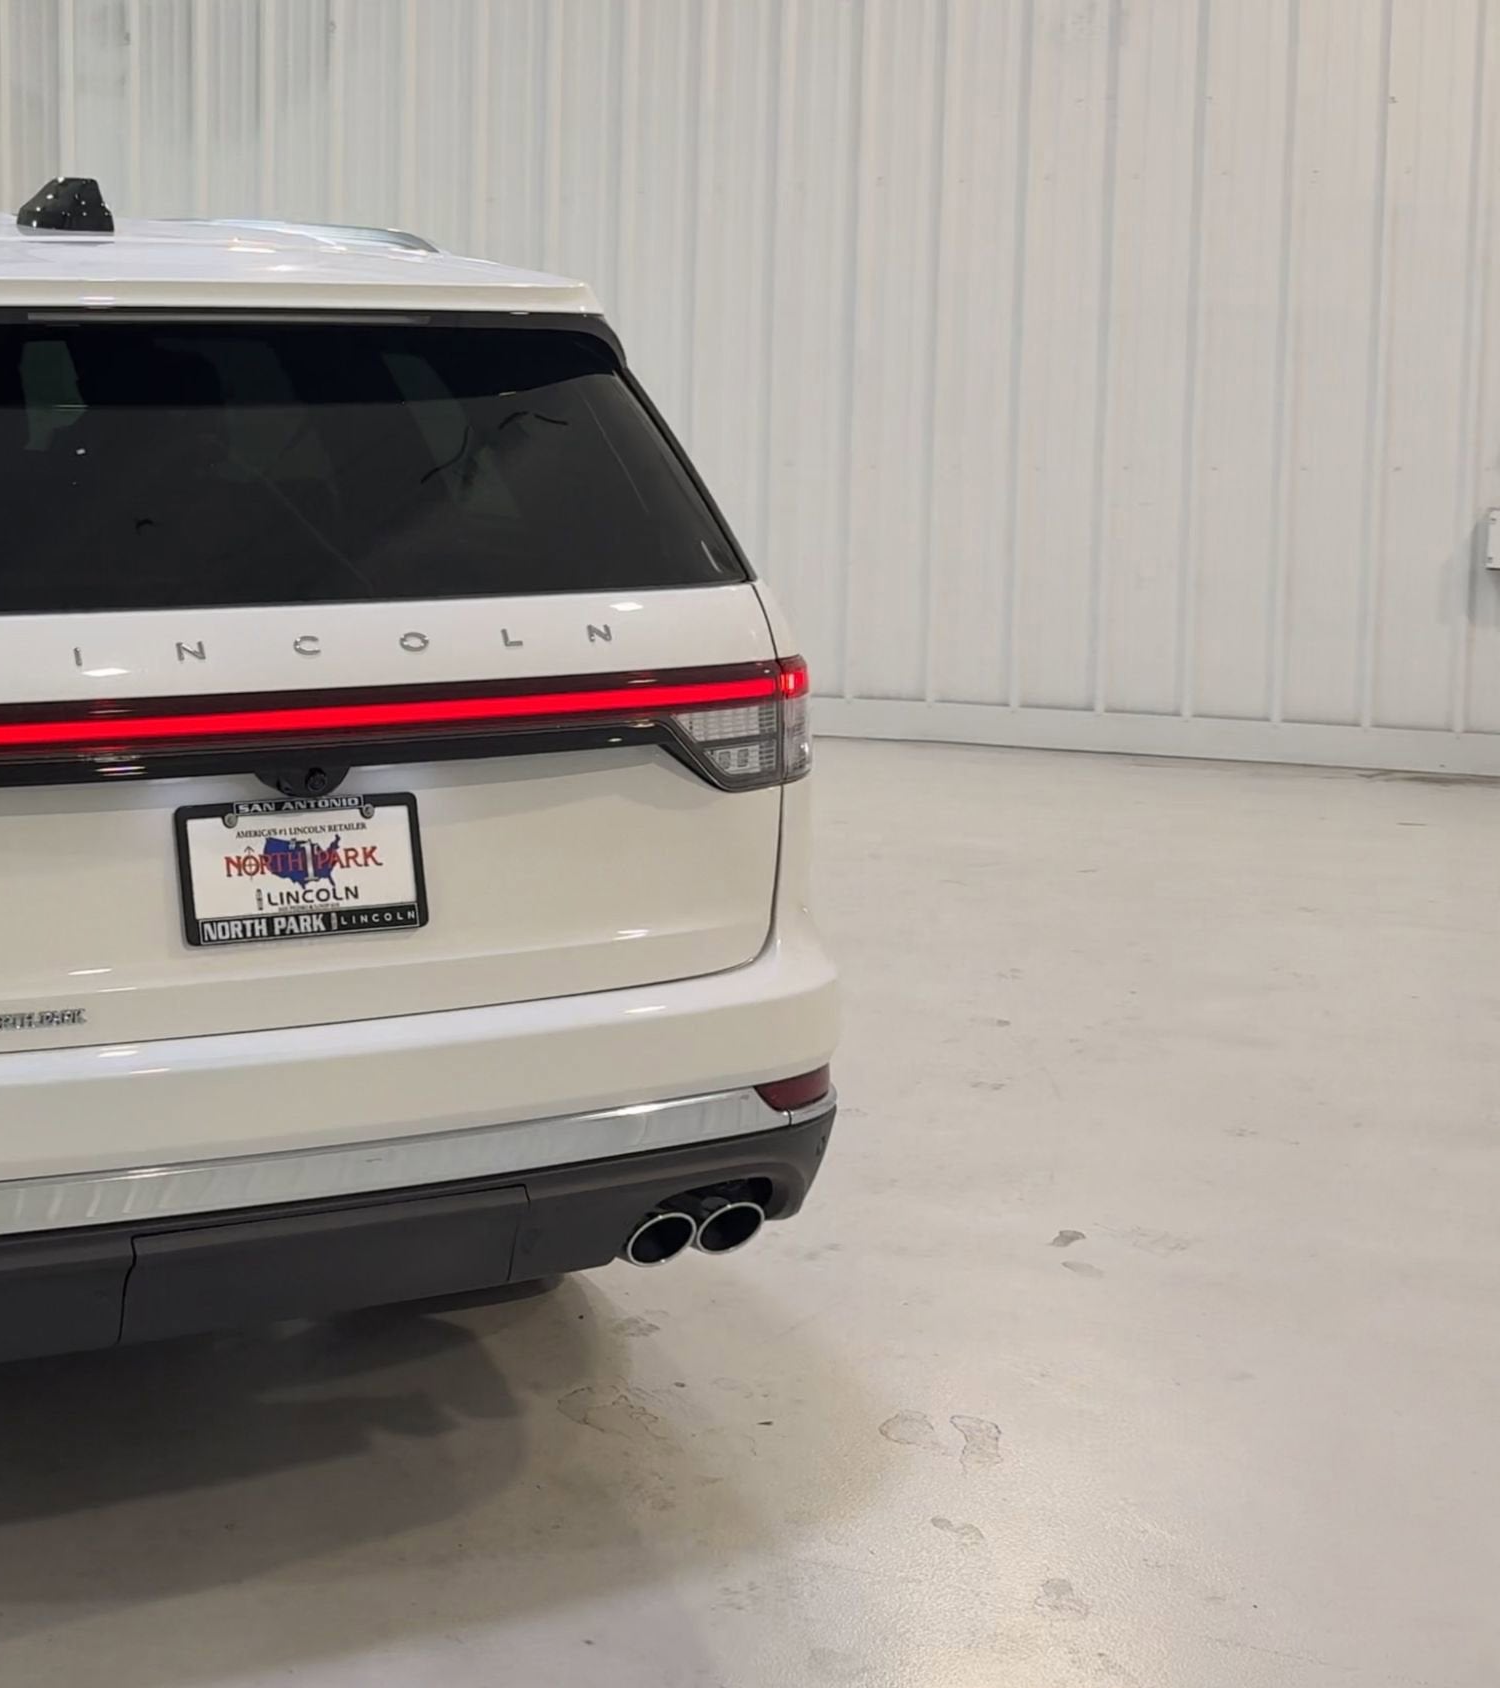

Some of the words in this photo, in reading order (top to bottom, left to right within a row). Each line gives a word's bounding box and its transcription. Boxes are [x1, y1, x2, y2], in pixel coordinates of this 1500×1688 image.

[238, 802, 276, 814] SAN
[282, 797, 360, 811] ANTONIO
[236, 827, 278, 839] AMERICA'S
[289, 824, 327, 836] LINCOLN
[328, 822, 367, 833] RETAILER
[224, 849, 304, 878] NORTH
[316, 845, 384, 870] PARK
[267, 885, 359, 906] LINCOLN
[204, 917, 268, 941] NORTH
[273, 913, 326, 936] PARK
[341, 909, 416, 926] LINCOLN
